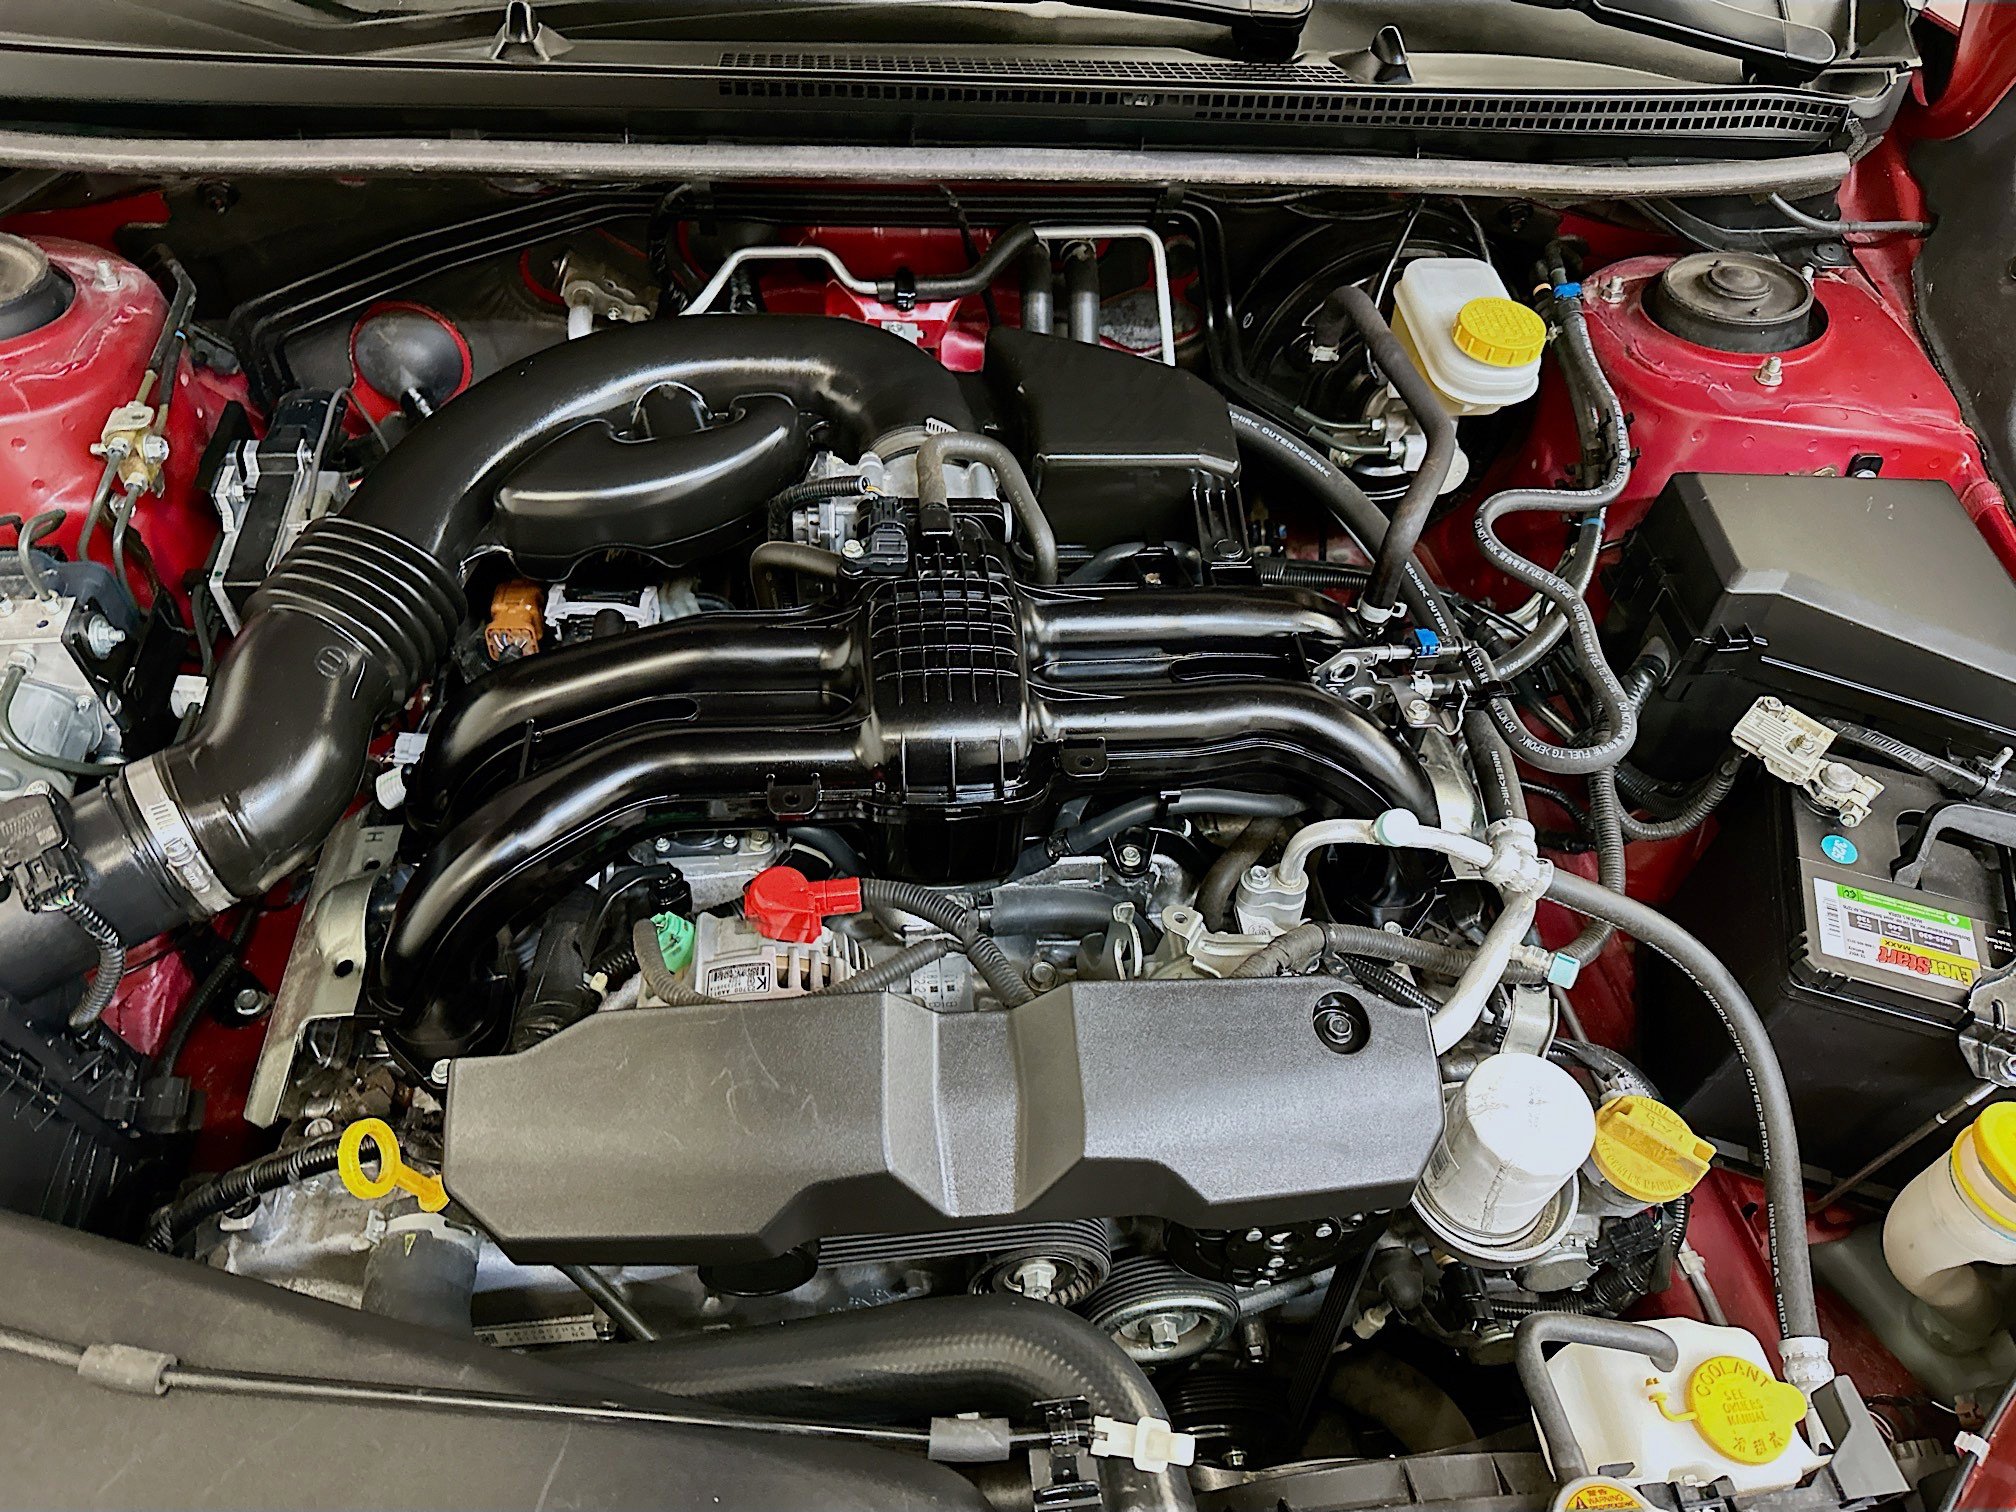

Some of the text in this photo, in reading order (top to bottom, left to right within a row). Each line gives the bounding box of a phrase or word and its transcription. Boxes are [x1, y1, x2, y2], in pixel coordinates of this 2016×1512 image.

[1526, 566, 1545, 581] FUEL
[1568, 749, 1592, 760] FUEL
[1884, 940, 1911, 952] MAXX
[1878, 945, 1974, 987] EverStart
[757, 976, 767, 990] K
[1695, 1360, 1773, 1397] COOLANT
[1723, 1388, 1747, 1402] SEE
[1726, 1410, 1770, 1426] MANUAL
